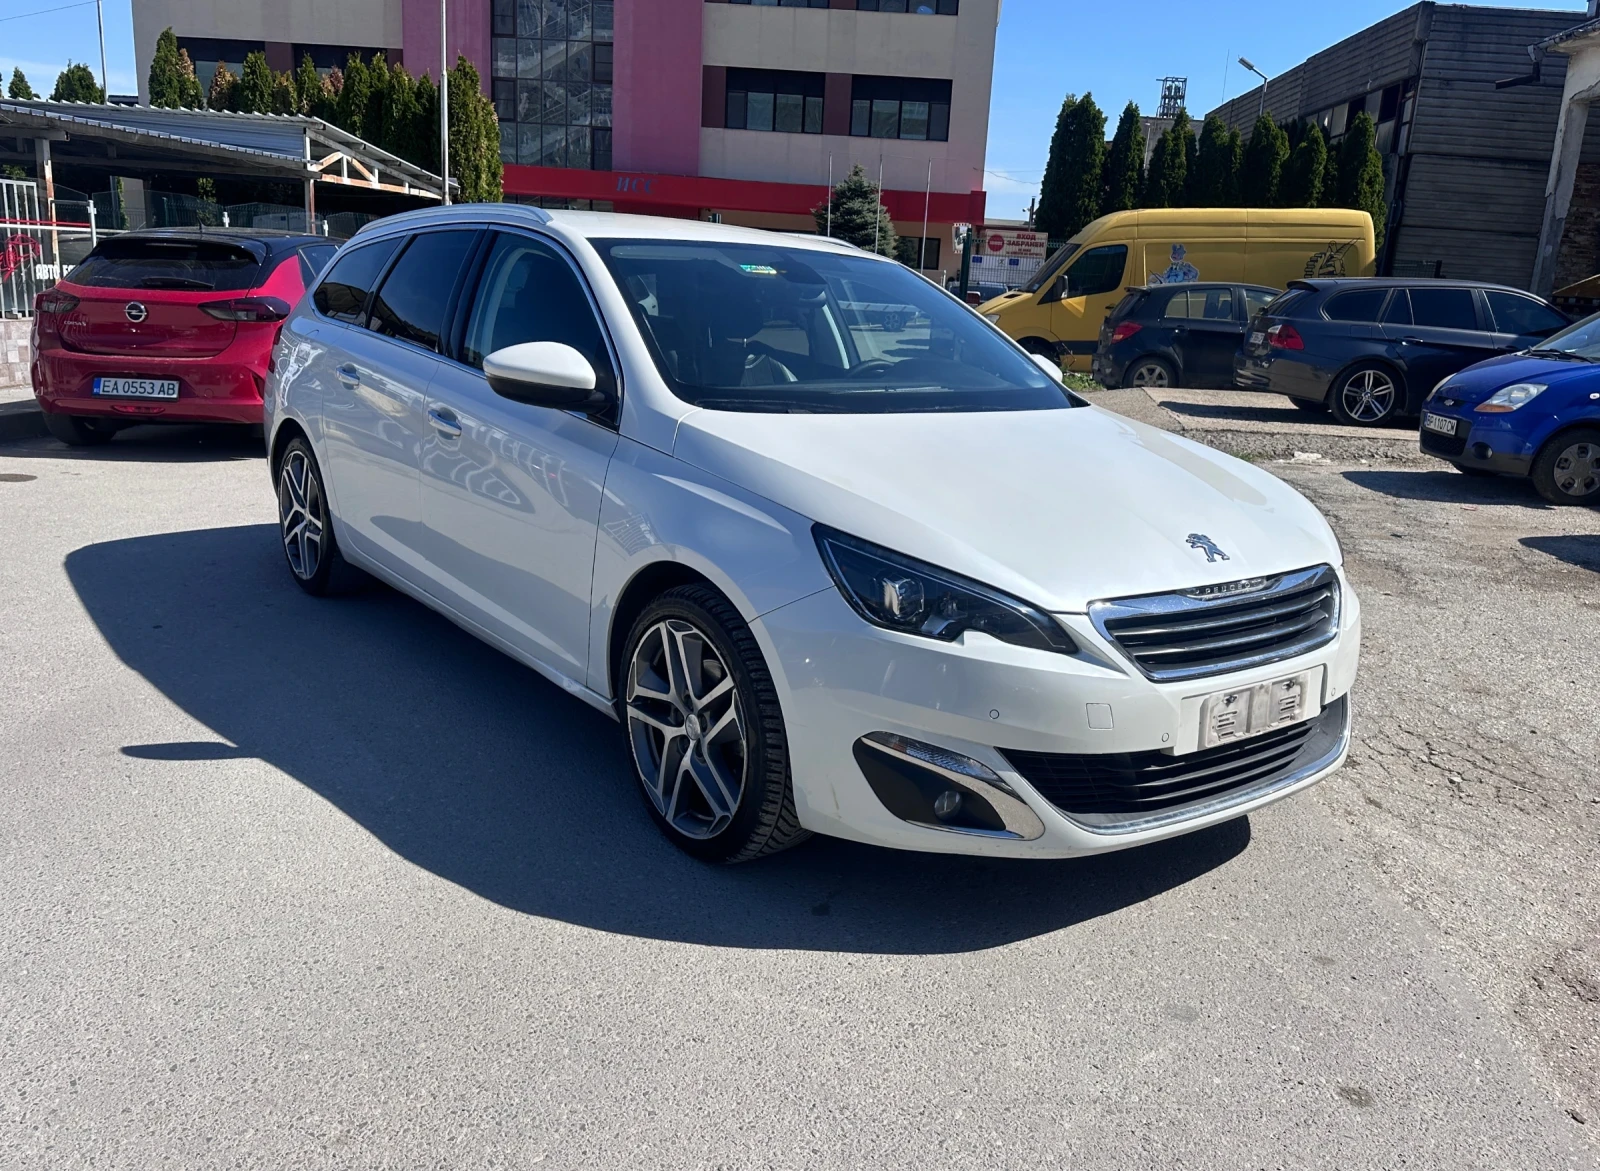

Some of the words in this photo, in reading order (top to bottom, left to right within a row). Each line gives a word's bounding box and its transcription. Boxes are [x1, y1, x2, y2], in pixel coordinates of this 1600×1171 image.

[1006, 240, 1044, 248] ЗАБРАНЕН
[1016, 233, 1036, 241] ВХОД
[36, 264, 60, 280] АВТО
[102, 380, 119, 393] EA
[122, 381, 155, 395] 0553
[158, 382, 175, 396] AB
[1205, 580, 1260, 595] PEUGEO
